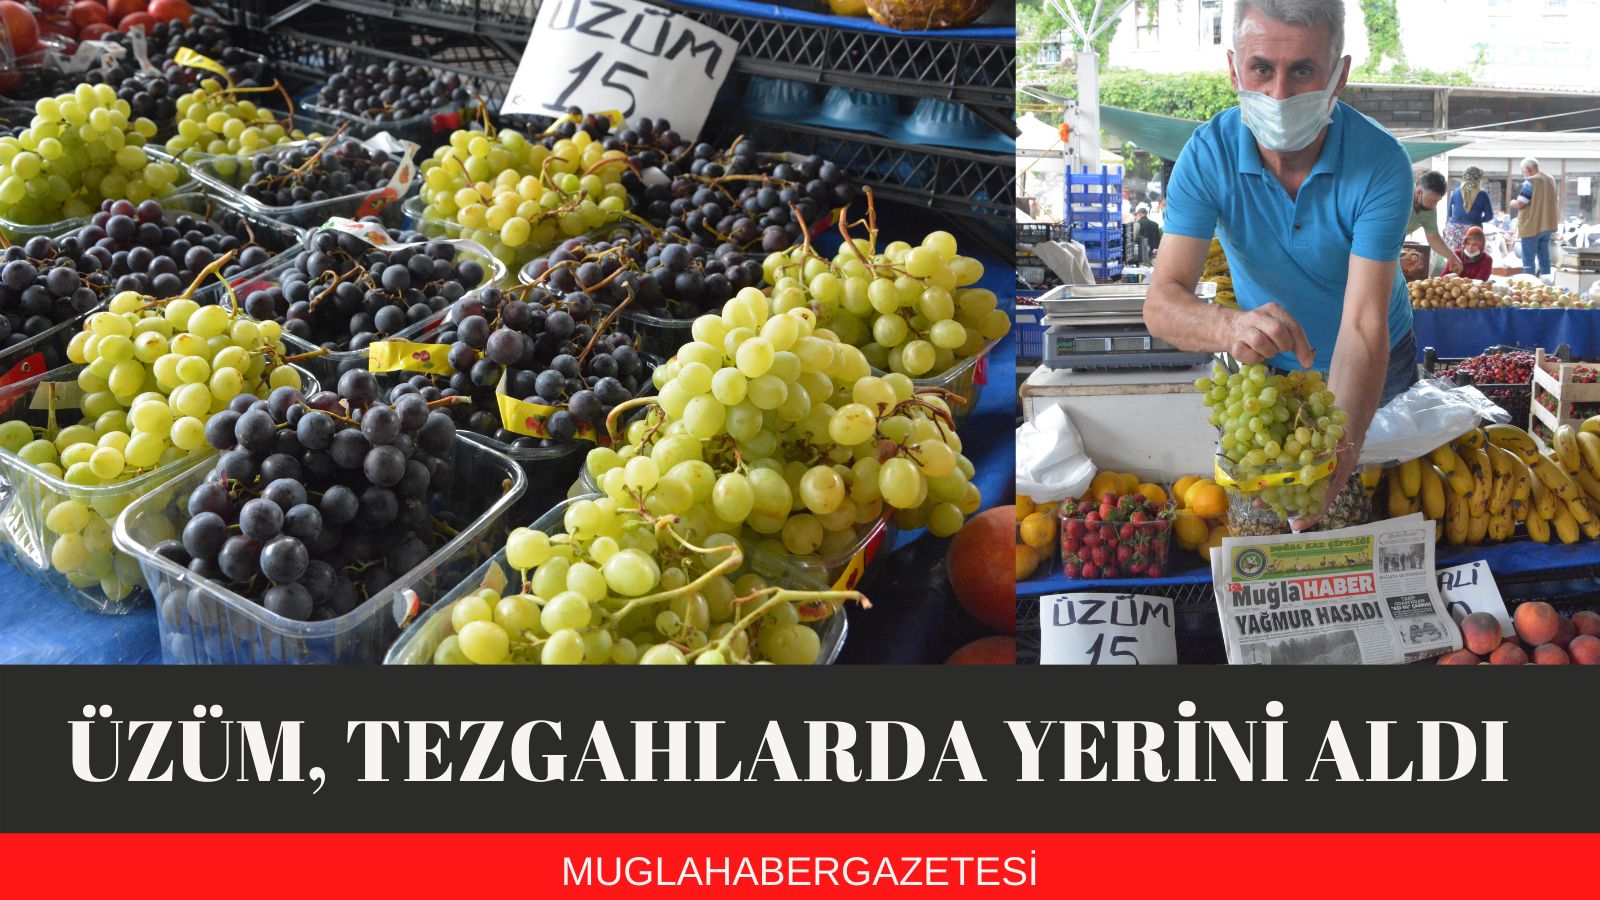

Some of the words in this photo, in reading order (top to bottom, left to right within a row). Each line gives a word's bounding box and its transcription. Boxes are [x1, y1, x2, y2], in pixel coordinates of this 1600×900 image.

[542, 51, 649, 119] 15
[1270, 542, 1302, 552] DOĞAL
[1232, 581, 1300, 609] Muğla
[1303, 575, 1375, 598] HABER
[1437, 562, 1481, 593] ALİ
[1053, 594, 1171, 628] ÜZÜM
[1235, 609, 1314, 635] YAĞMUR
[1315, 601, 1383, 625] HASADI
[1085, 633, 1139, 665] 15
